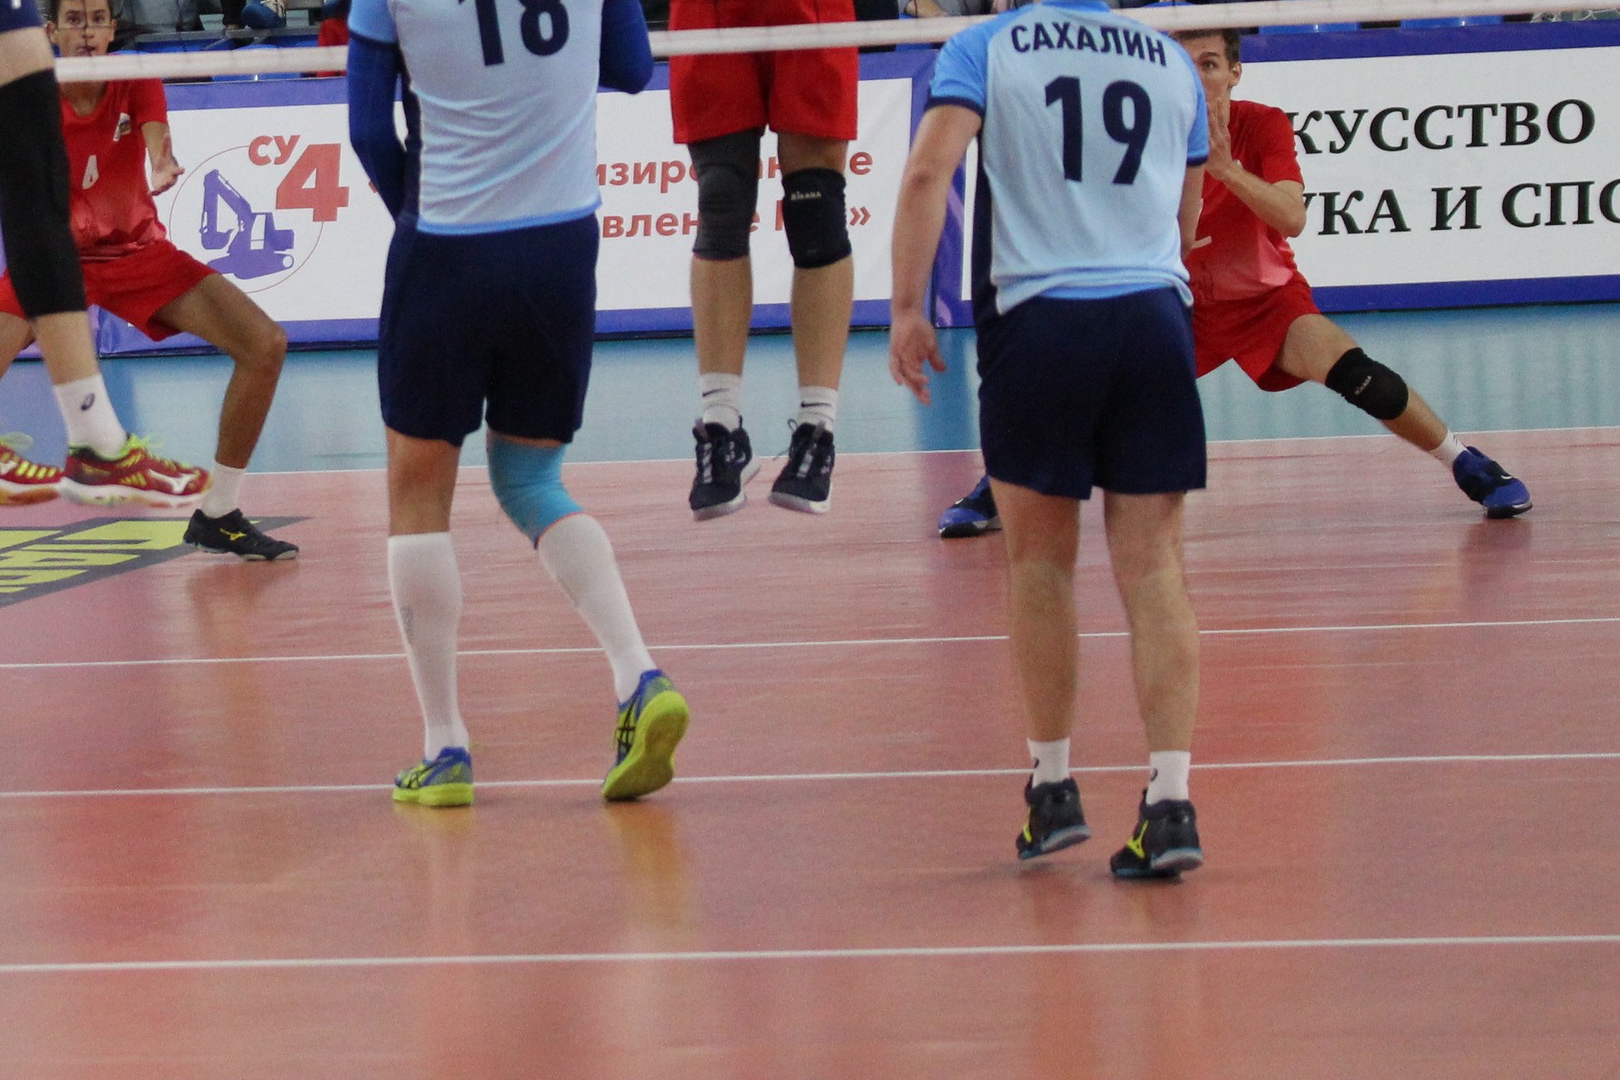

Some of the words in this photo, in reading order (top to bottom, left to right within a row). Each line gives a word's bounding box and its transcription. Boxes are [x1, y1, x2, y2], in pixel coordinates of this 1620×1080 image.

[1010, 21, 1167, 67] САХАЛИН
[1044, 75, 1152, 185] 19
[275, 143, 350, 223] 4
[1430, 185, 1483, 231] И
